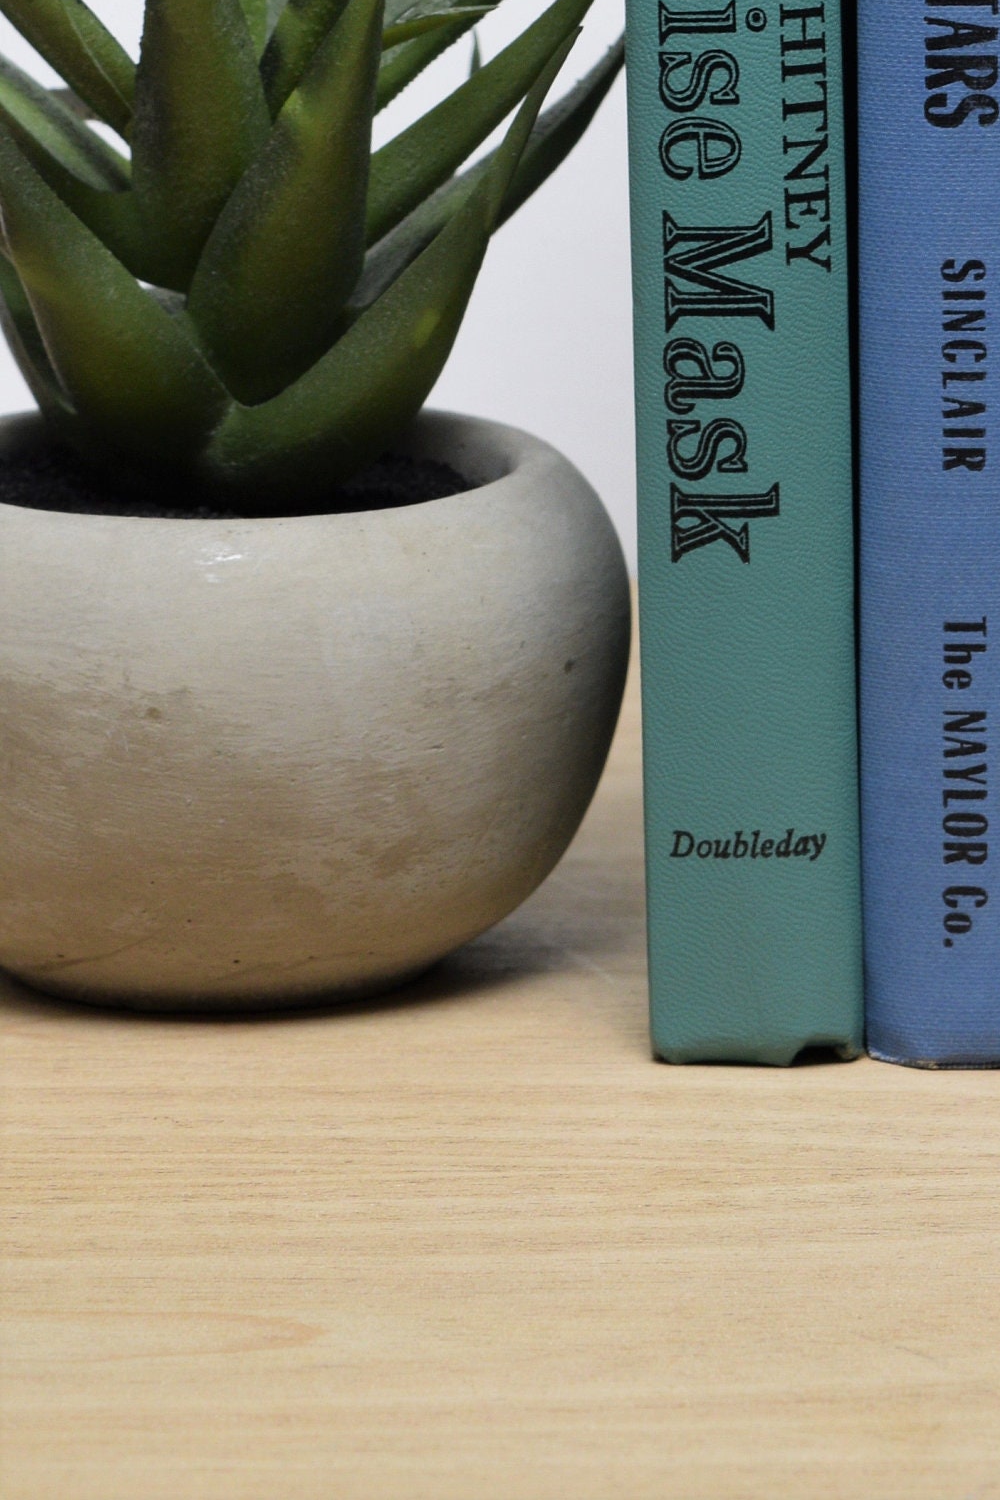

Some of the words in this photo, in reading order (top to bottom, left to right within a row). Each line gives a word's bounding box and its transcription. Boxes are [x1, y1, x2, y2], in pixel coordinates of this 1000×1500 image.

[663, 210, 779, 563] Mask
[941, 260, 986, 471] SINCLAIR
[943, 617, 986, 689] The
[943, 711, 988, 864] NAYLOR
[670, 829, 826, 861] Doubleday
[943, 886, 988, 947] Co.
